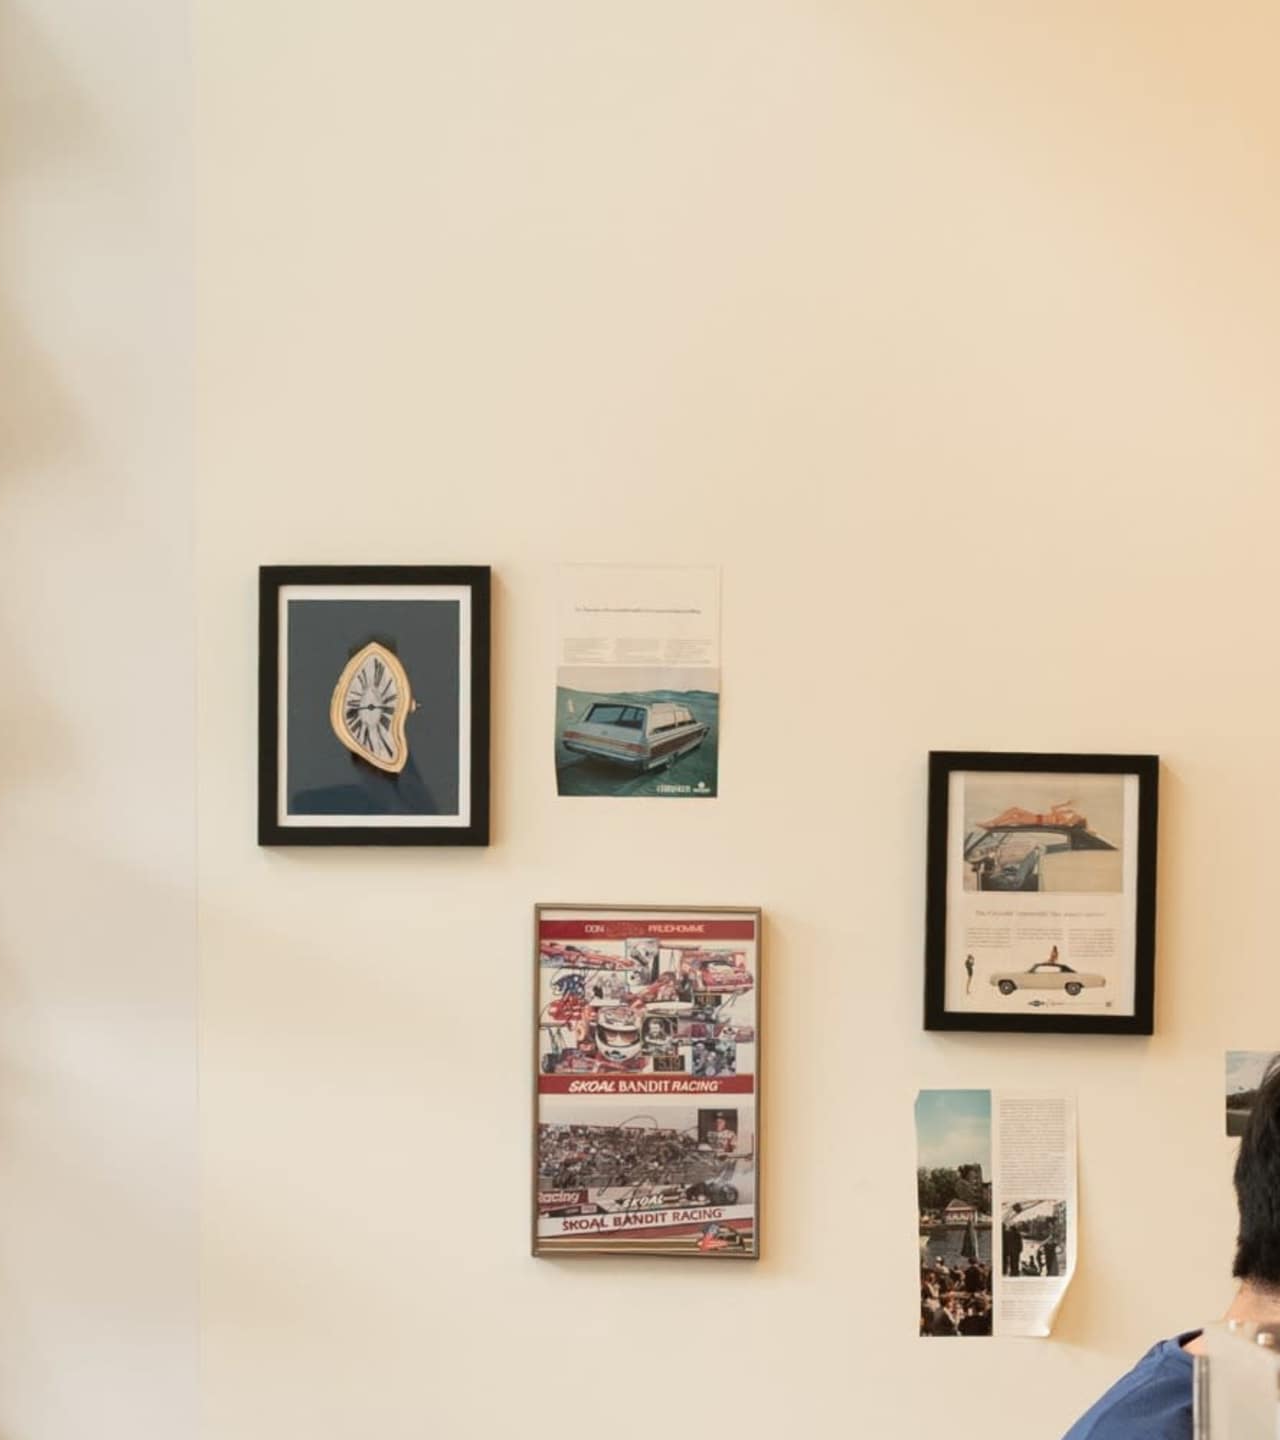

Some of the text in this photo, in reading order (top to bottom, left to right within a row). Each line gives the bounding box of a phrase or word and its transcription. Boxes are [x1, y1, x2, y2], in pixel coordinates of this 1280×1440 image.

[568, 1079, 719, 1093] SKOAL BANDIT RACING
[623, 1194, 665, 1209] SKOAL
[562, 1208, 722, 1232] SKOAL BANDIT RACING
